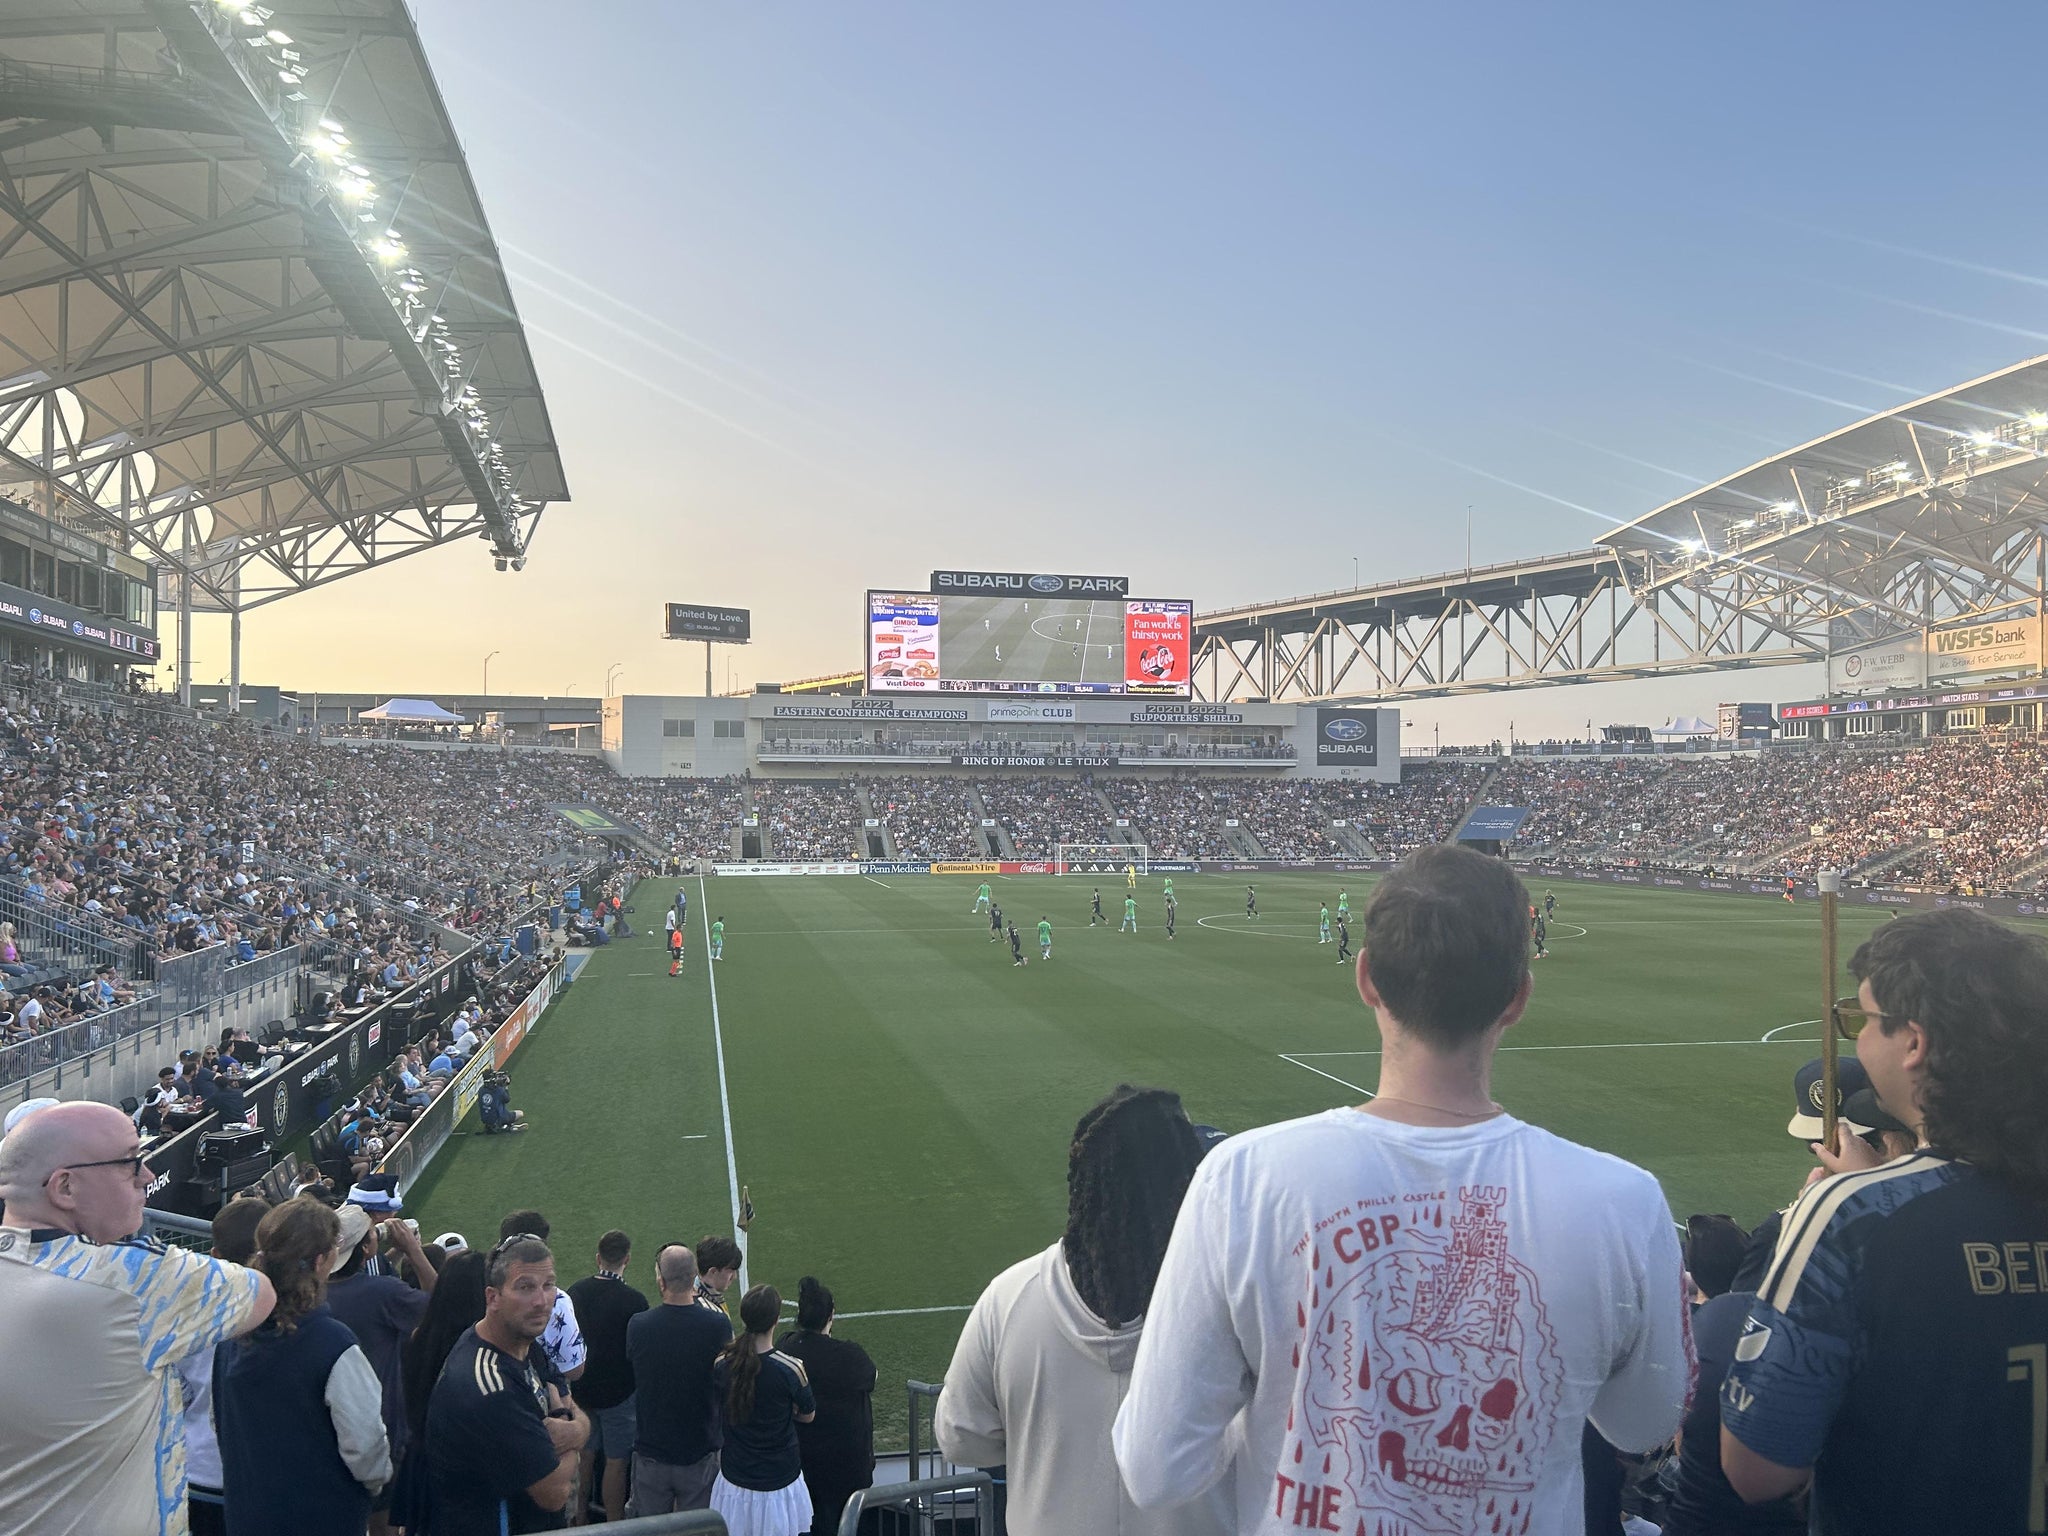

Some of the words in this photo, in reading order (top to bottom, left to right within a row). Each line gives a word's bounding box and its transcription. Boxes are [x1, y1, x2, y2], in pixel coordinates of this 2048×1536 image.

[938, 574, 1023, 588] SUBARU
[1068, 578, 1124, 592] PARK
[43, 614, 67, 629] SUBARU
[675, 609, 705, 619] United
[707, 611, 719, 622] by
[720, 612, 744, 623] Love.
[1133, 619, 1150, 629] Fan
[1151, 619, 1173, 629] work
[1173, 620, 1181, 630] is
[84, 626, 106, 640] SUBARU
[1131, 630, 1160, 641] thirsty
[1161, 631, 1183, 640] work
[1936, 625, 1994, 653] WSFS
[1995, 626, 2025, 644] bank
[1880, 653, 1905, 666] WEBB
[1951, 656, 1975, 667] Stand
[1977, 654, 1992, 664] For
[1942, 694, 1961, 703] MATCH
[1961, 692, 1979, 701] STATS
[854, 700, 891, 709] 2022
[1191, 706, 1224, 714] 2025
[776, 707, 826, 717] EASTERN
[828, 708, 900, 718] CONFERENCE
[902, 709, 966, 719] CHAMPIONS
[990, 706, 1040, 718] primepoint
[1042, 708, 1073, 718] CLUB
[1133, 713, 1202, 722] SUPPORTERS'
[1203, 713, 1240, 723] SHIELD
[1318, 744, 1374, 754] SUBARU
[961, 757, 989, 765] RING
[991, 757, 1006, 766] OF
[1008, 757, 1045, 766] HONOR
[1057, 757, 1073, 766] LE
[1075, 757, 1110, 767] TOUX
[869, 864, 891, 873] Penn
[891, 863, 930, 873] Medicine
[936, 864, 974, 873] Continental
[1761, 886, 1785, 894] SUBARU
[1881, 895, 1911, 903] SUBARU
[301, 1065, 320, 1087] SUBARU
[327, 1053, 338, 1070] PARK
[146, 1169, 171, 1198] PARK
[1292, 1231, 1311, 1257] THE
[1314, 1206, 1351, 1233] SOUTH
[1357, 1194, 1396, 1210] PHILLY
[1403, 1191, 1446, 1203] CASTLE
[1333, 1214, 1400, 1264] CBP
[1275, 1470, 1343, 1534] THE
